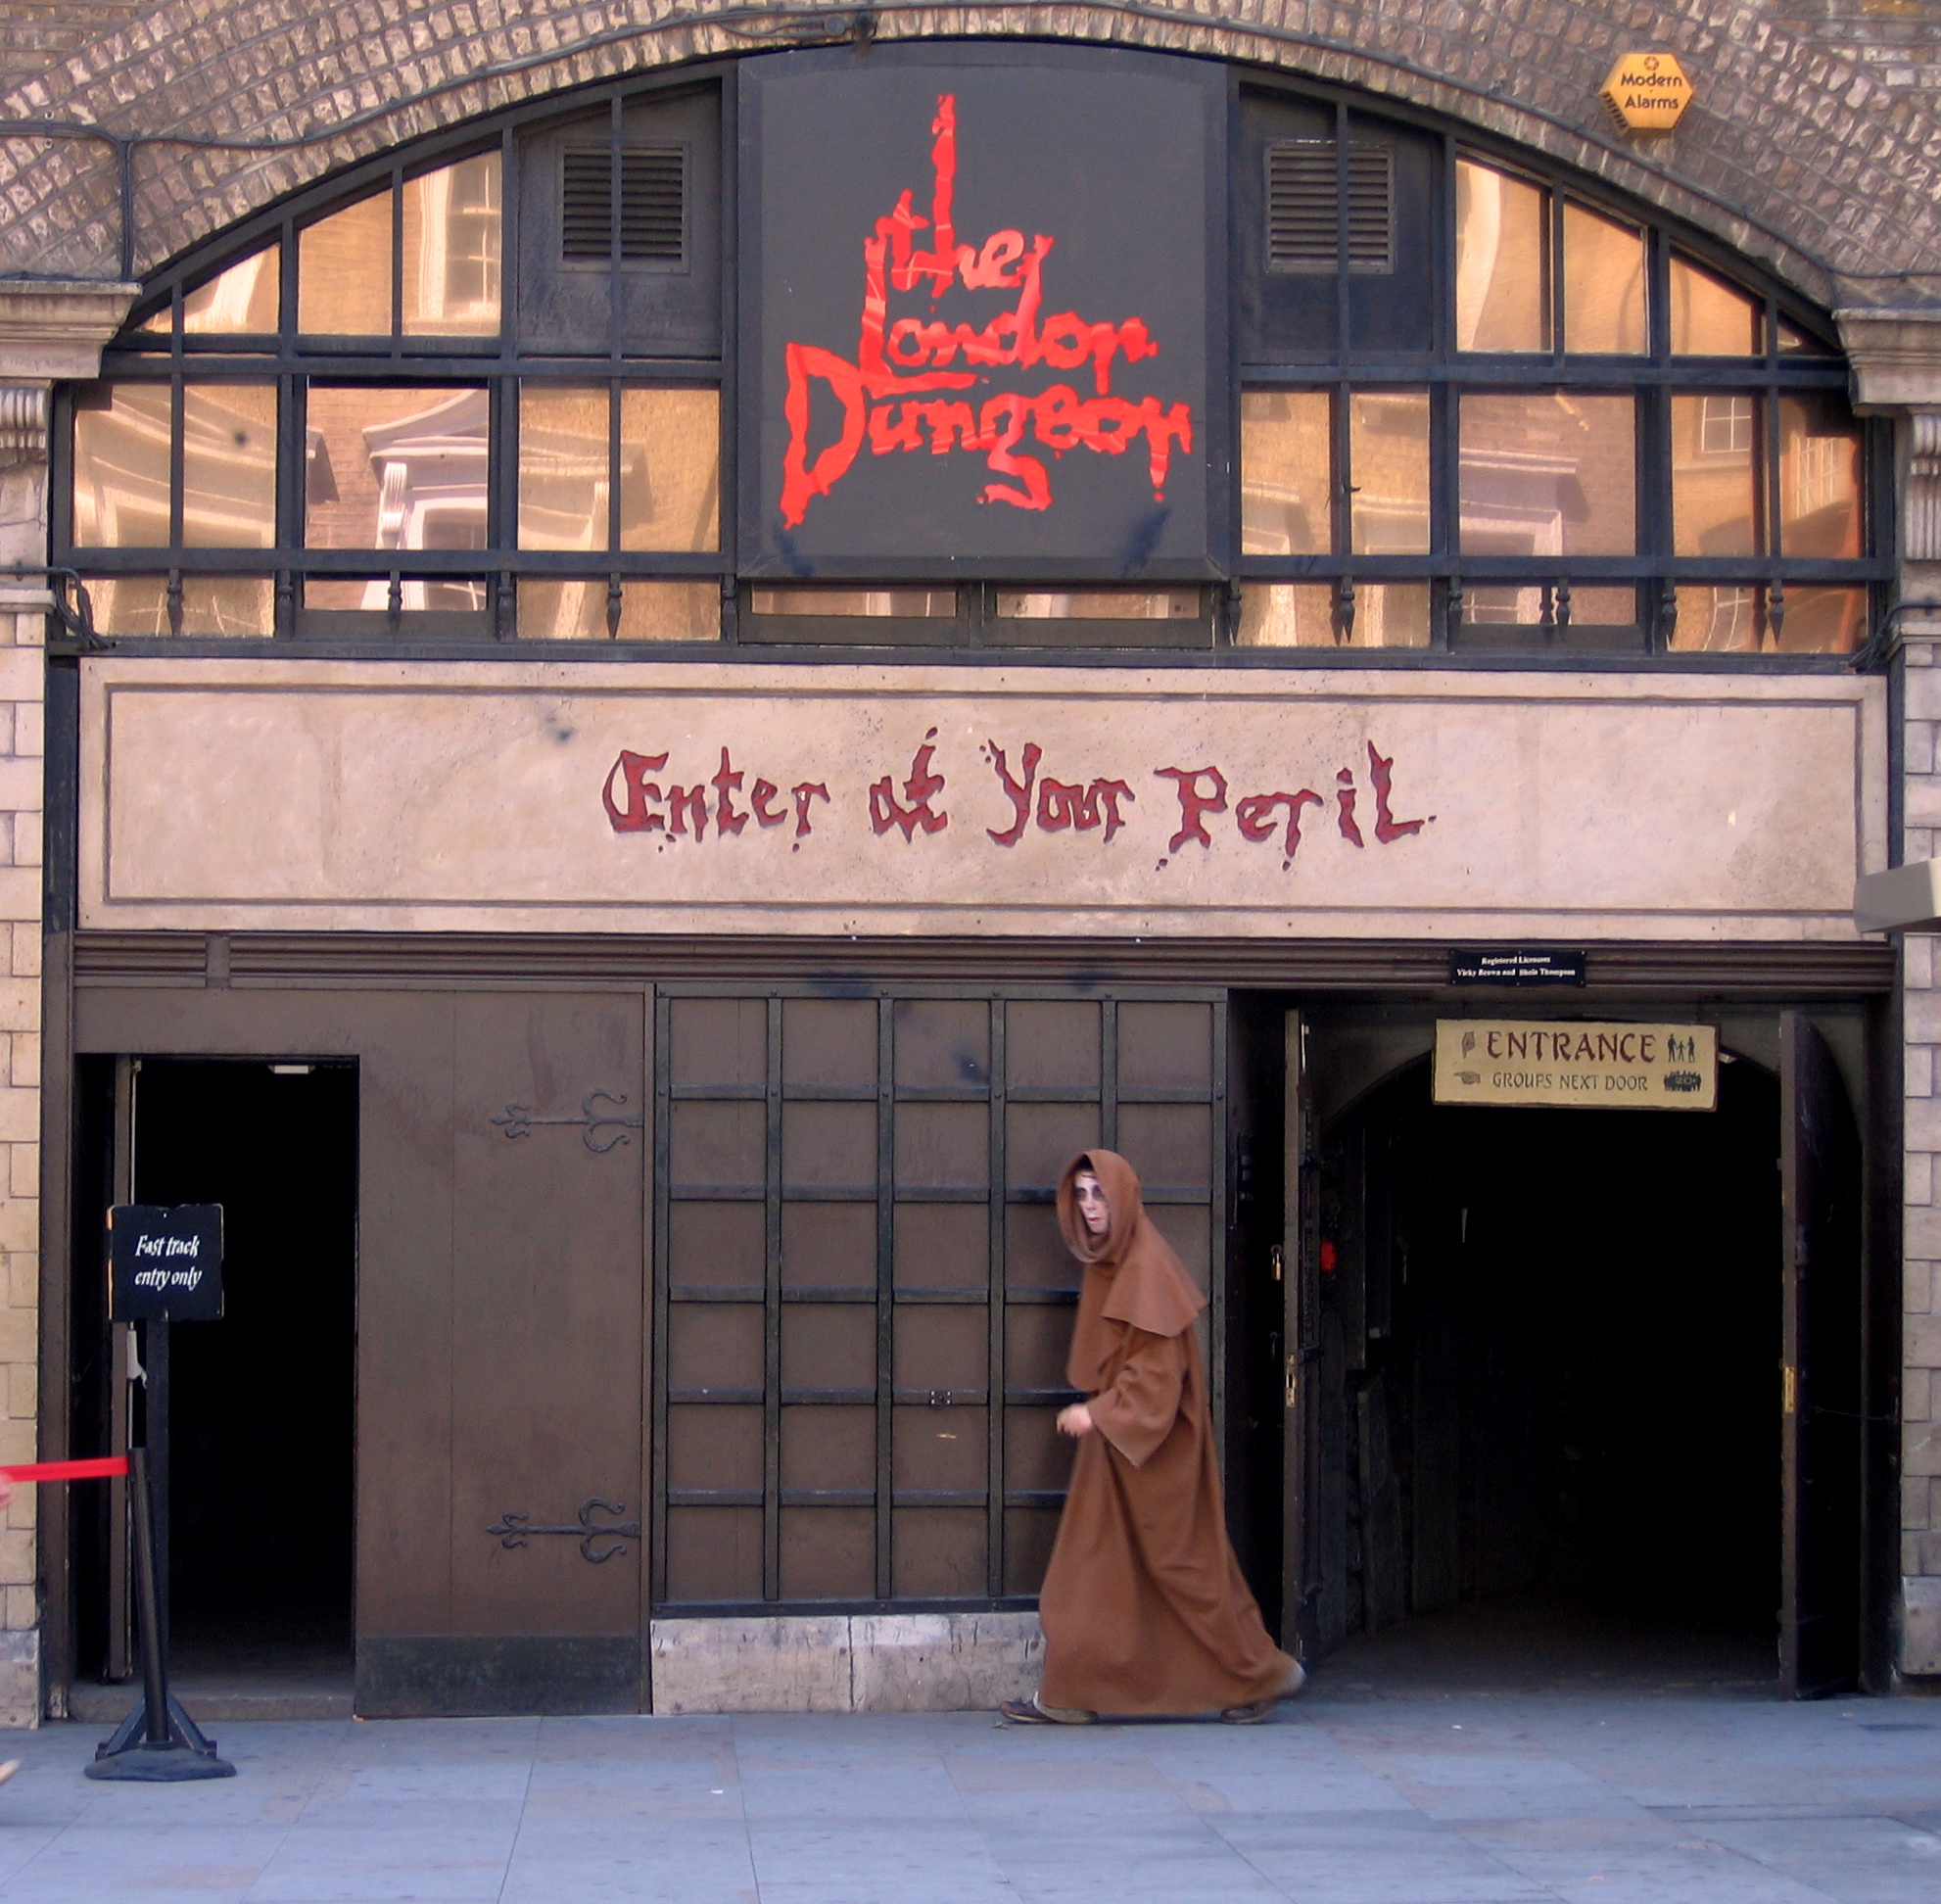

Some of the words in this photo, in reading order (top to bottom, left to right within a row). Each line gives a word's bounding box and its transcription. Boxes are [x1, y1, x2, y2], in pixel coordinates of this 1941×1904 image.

[1621, 71, 1682, 87] Modern
[1624, 93, 1679, 109] Alarms
[859, 233, 1160, 400] London
[781, 341, 1193, 530] Dungeon
[602, 746, 830, 852] Enter
[869, 727, 948, 844] at
[980, 739, 1136, 848] Your
[1481, 956, 1517, 966] Registered
[1539, 968, 1576, 977] Thompson
[1487, 1030, 1657, 1064] ENTRANCE
[1492, 1071, 1553, 1090] GROUPS
[1559, 1073, 1600, 1091] NEXT
[1604, 1074, 1649, 1092] DOOR
[134, 1234, 166, 1257] Fast
[166, 1234, 201, 1258] track
[134, 1267, 171, 1292] entry
[171, 1265, 203, 1292] only
